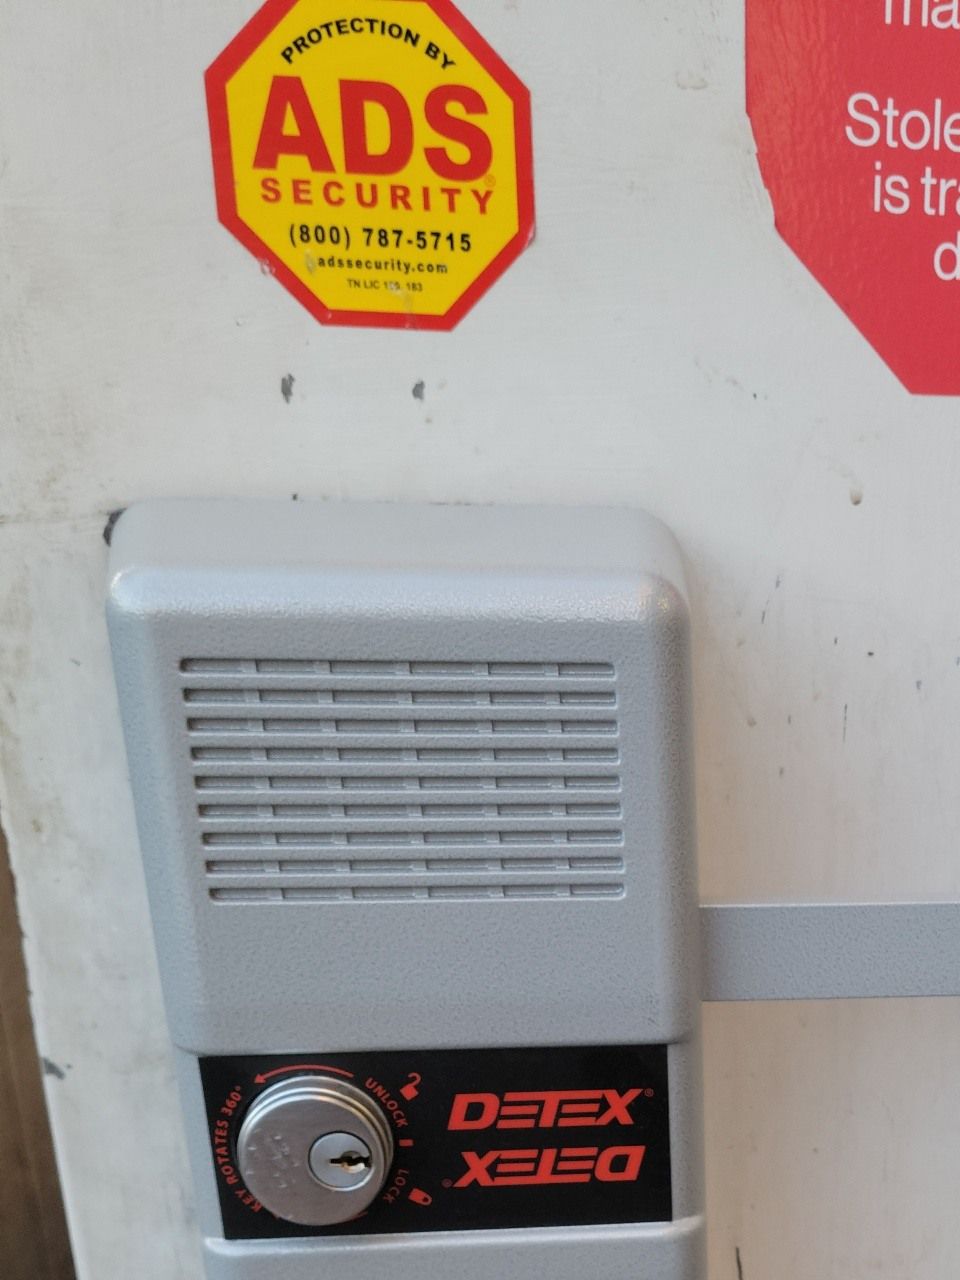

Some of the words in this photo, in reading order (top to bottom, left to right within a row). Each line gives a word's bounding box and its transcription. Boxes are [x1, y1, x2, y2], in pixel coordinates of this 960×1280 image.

[280, 18, 420, 64] PROTECTION
[424, 42, 456, 70] BY
[261, 177, 494, 215] SECURITY
[873, 160, 910, 215] is
[289, 224, 350, 249] (800)
[362, 227, 471, 253] 787-5715
[318, 256, 448, 274] adssecurity.com
[365, 1077, 408, 1129] UNLOCK
[213, 1119, 240, 1186] ROTATES
[234, 1188, 263, 1213] KEY
[383, 1168, 410, 1204] LOCK
